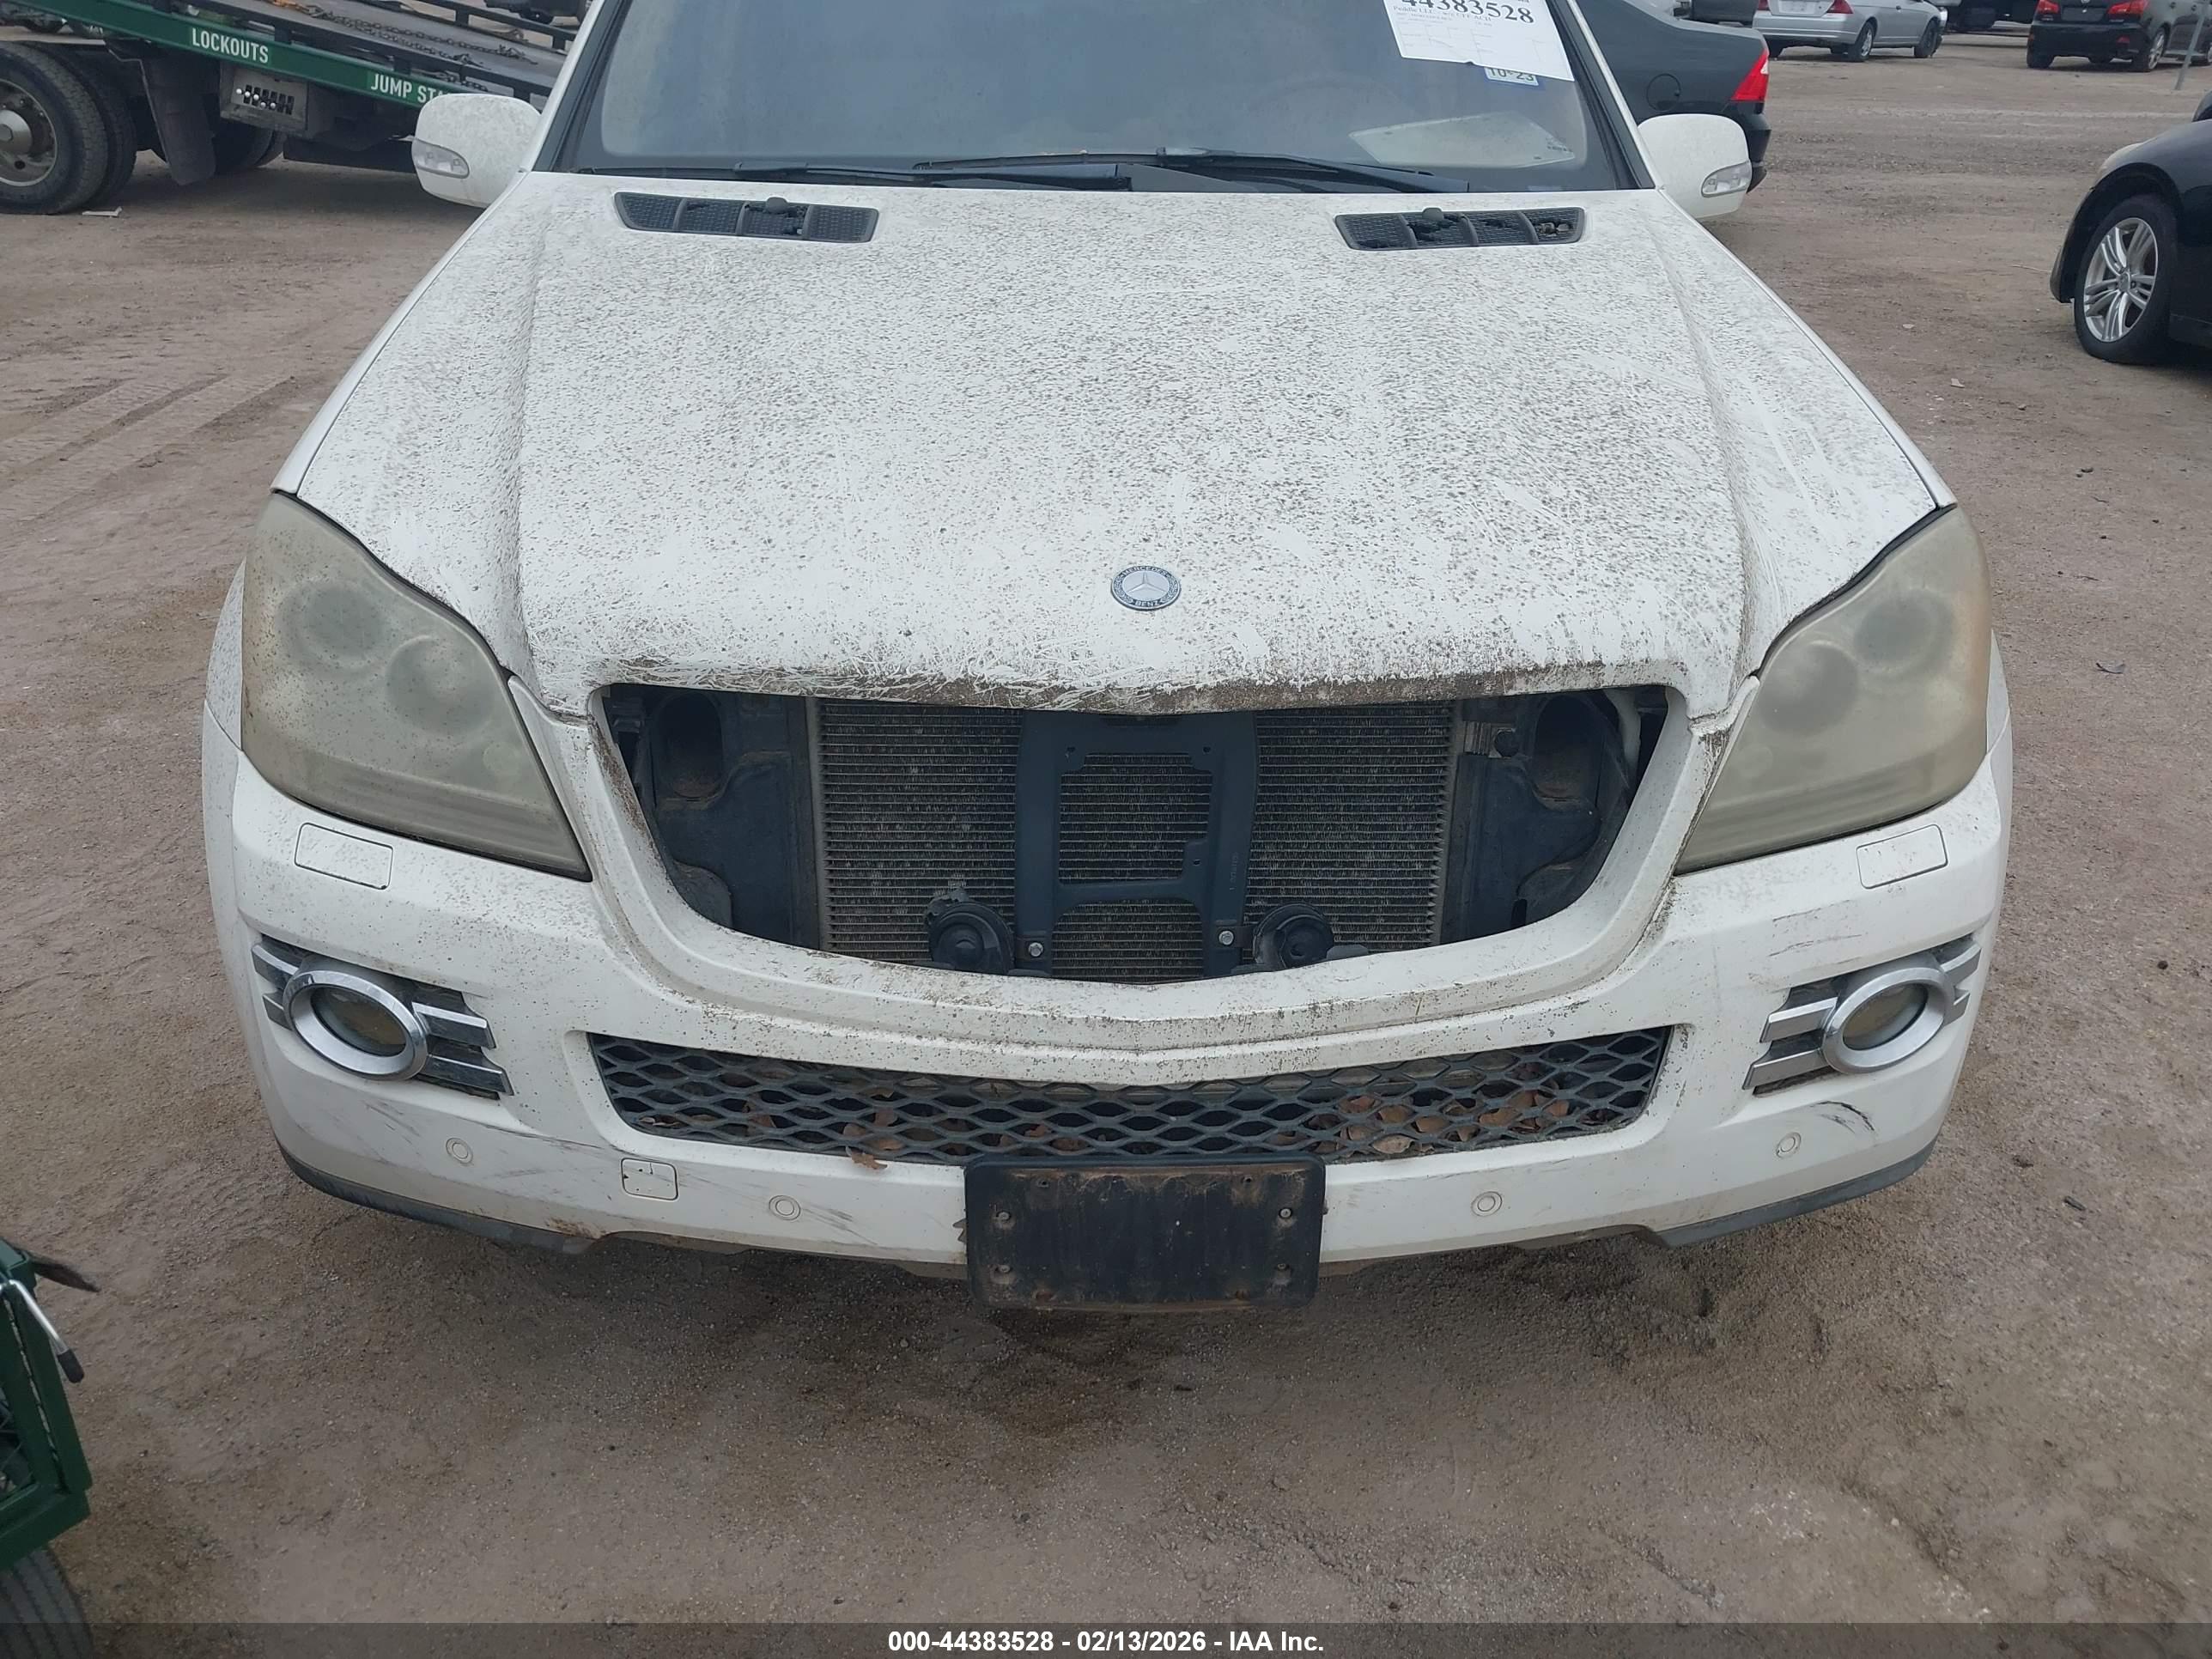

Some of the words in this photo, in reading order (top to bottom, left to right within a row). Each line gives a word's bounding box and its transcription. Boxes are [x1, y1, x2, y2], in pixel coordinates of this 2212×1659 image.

[191, 27, 269, 64] LOCKOUTS
[370, 74, 412, 98] JUMP
[417, 86, 452, 103] ST
[1122, 566, 1168, 576] MERCEDES
